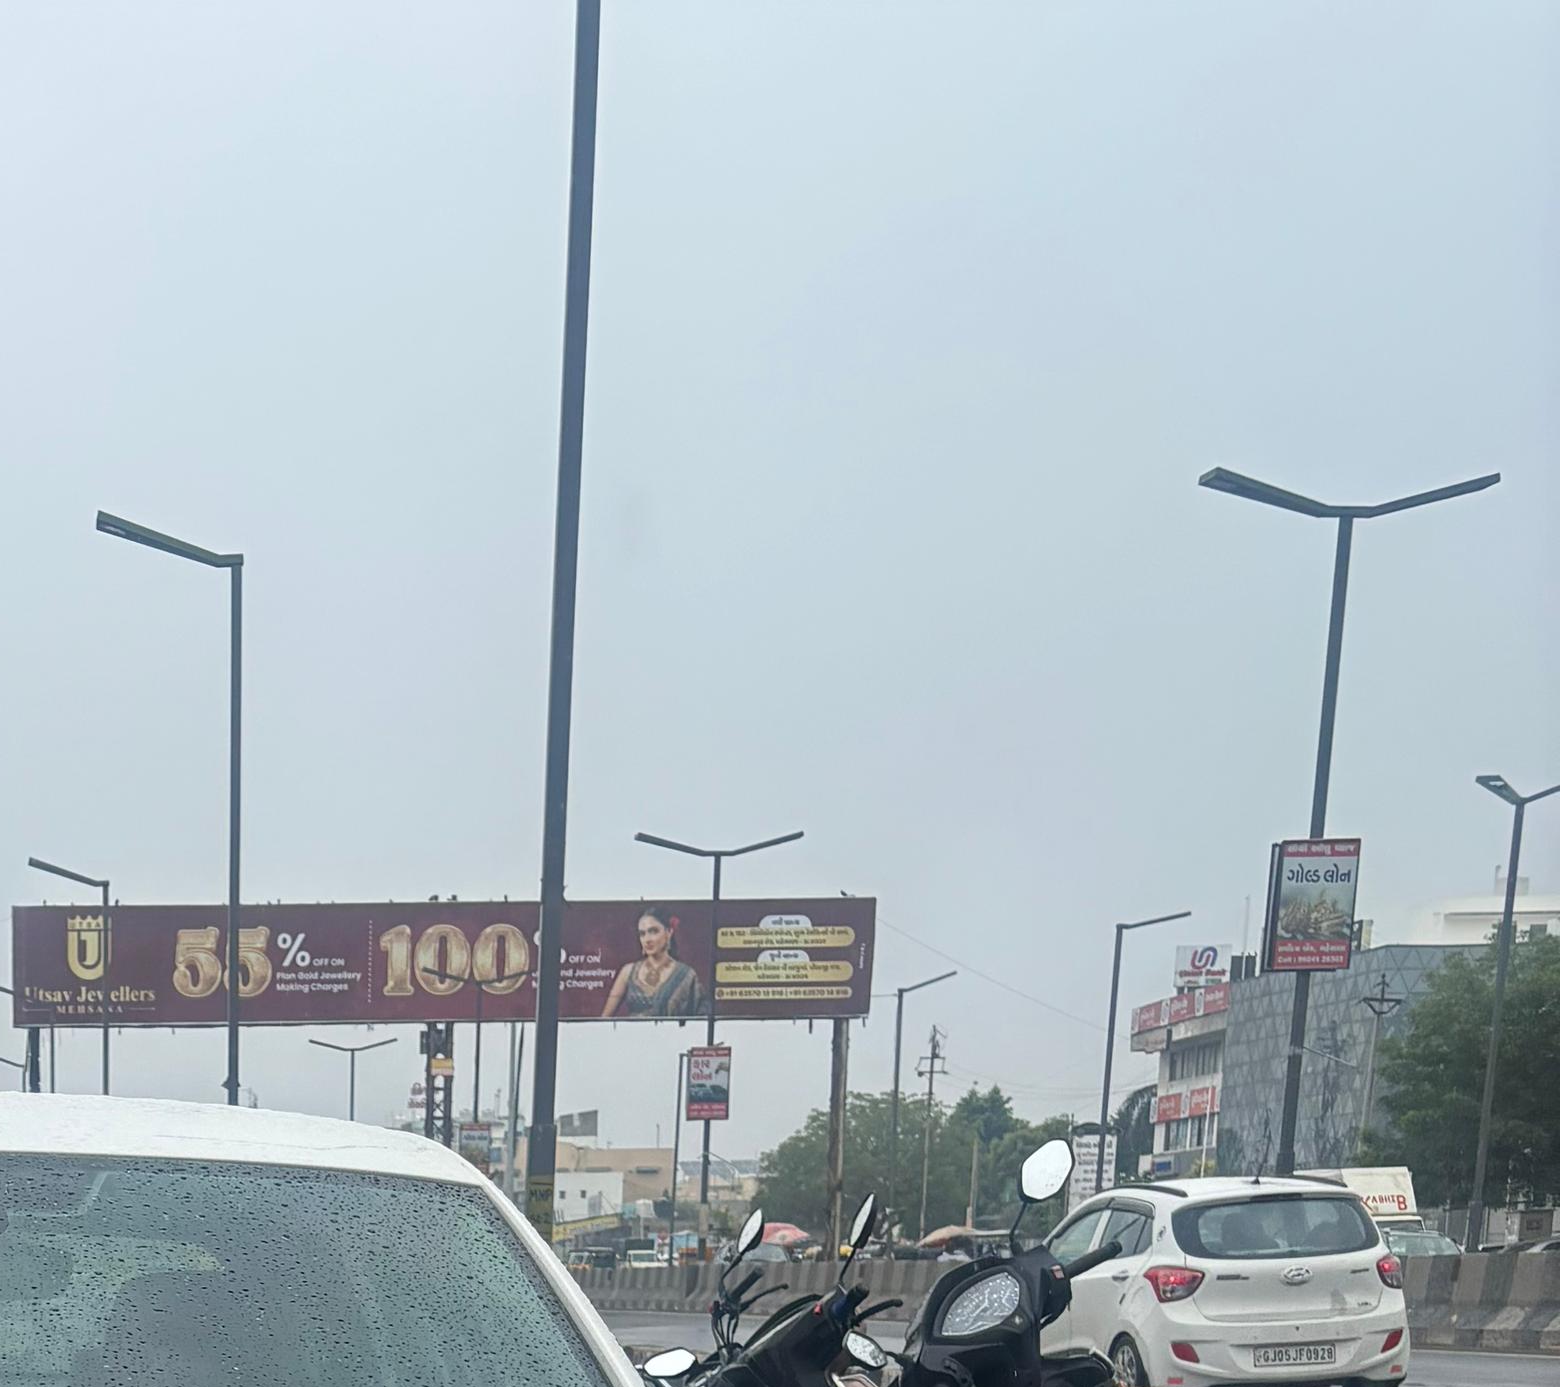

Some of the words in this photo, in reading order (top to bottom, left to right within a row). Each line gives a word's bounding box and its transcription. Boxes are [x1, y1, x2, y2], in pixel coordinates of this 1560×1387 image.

[1287, 863, 1320, 883] ગોલ્ડ
[1323, 862, 1352, 883] લોન
[312, 958, 329, 966] OFF
[330, 958, 345, 966] ON
